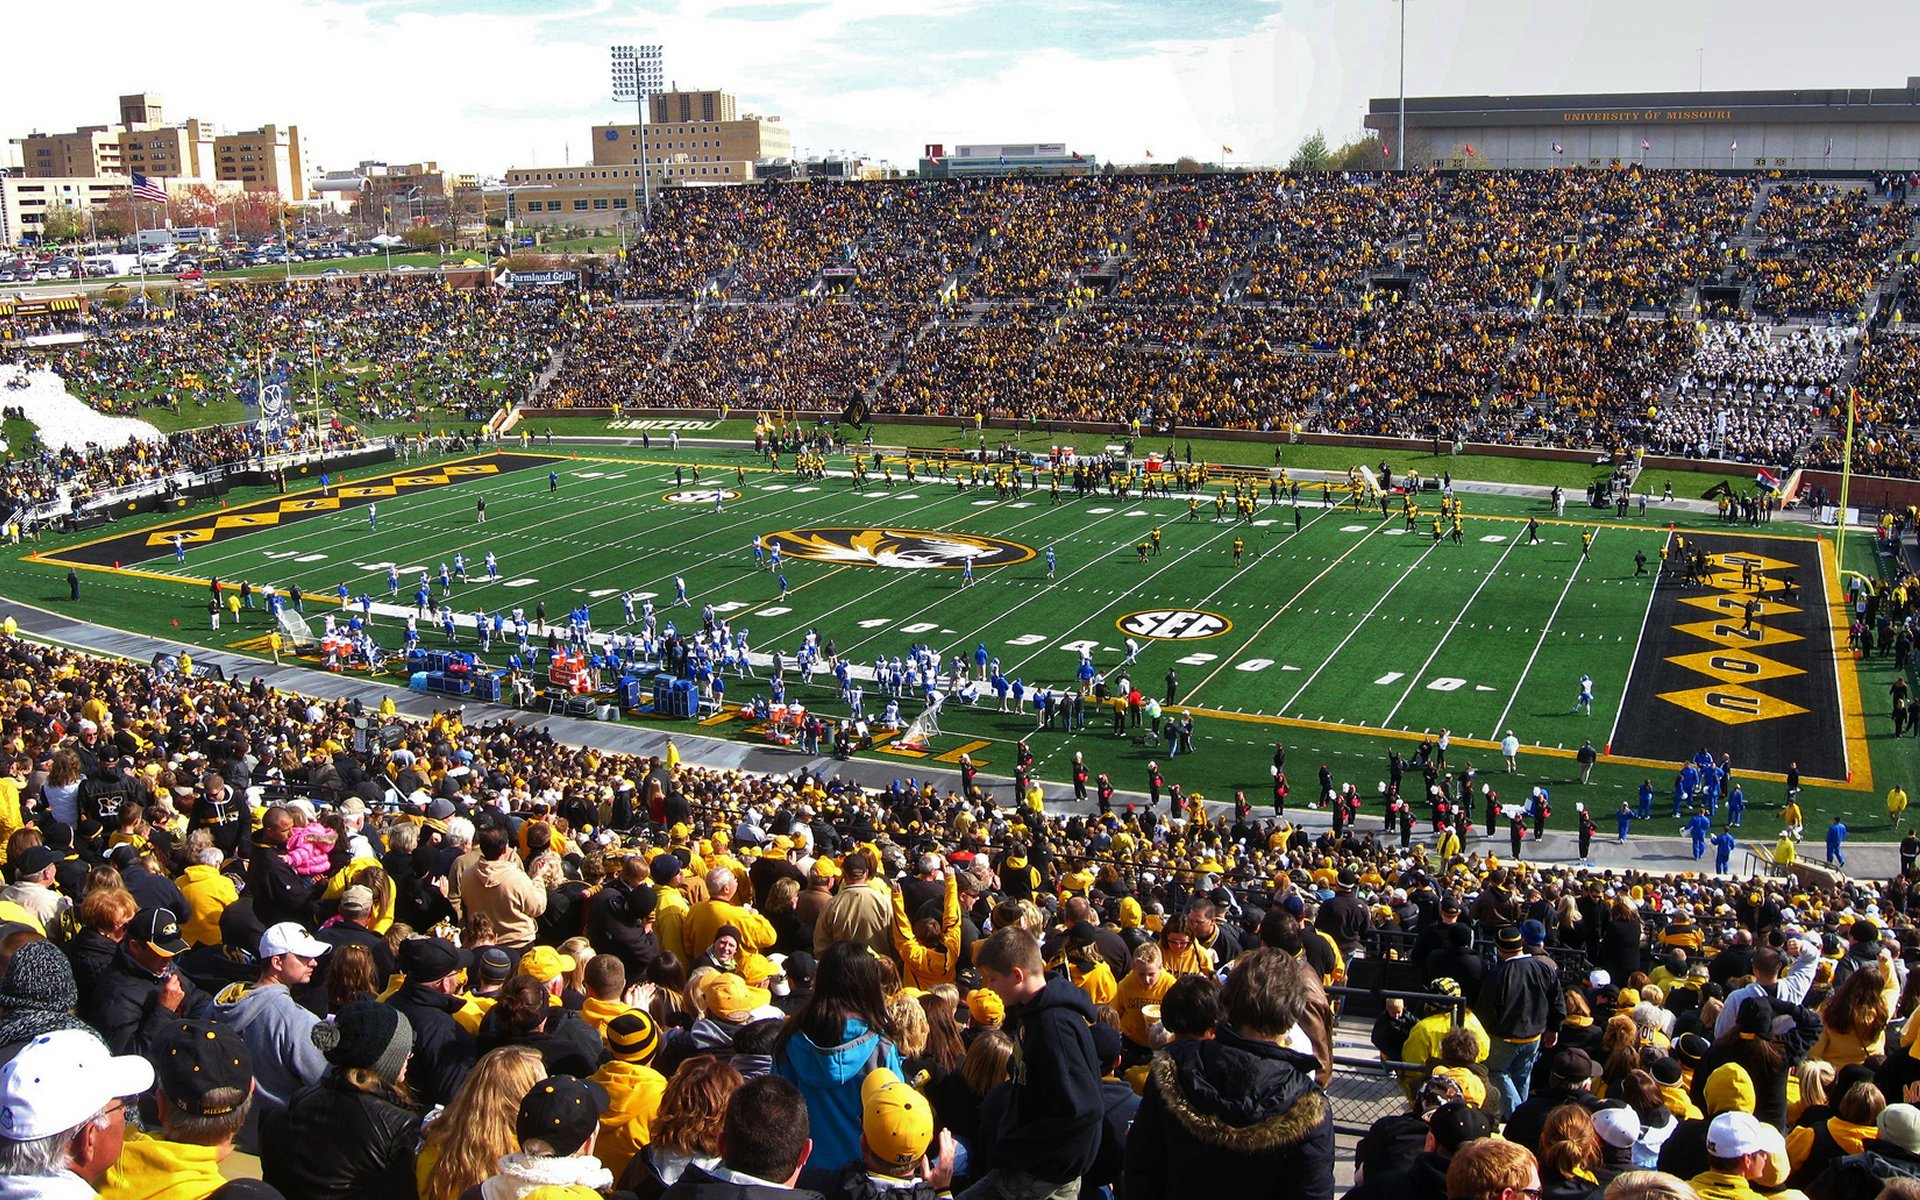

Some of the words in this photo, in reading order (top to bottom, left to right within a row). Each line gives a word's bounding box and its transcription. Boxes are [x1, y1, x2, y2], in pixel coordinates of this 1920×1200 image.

[1563, 112, 1640, 121] UNIVERSITY
[1644, 111, 1662, 120] OF
[1666, 110, 1732, 120] MISSOURI
[510, 272, 551, 281] Farmland
[553, 271, 576, 281] Grille
[606, 419, 721, 431] #MIZZOU
[1125, 611, 1224, 638] SEC
